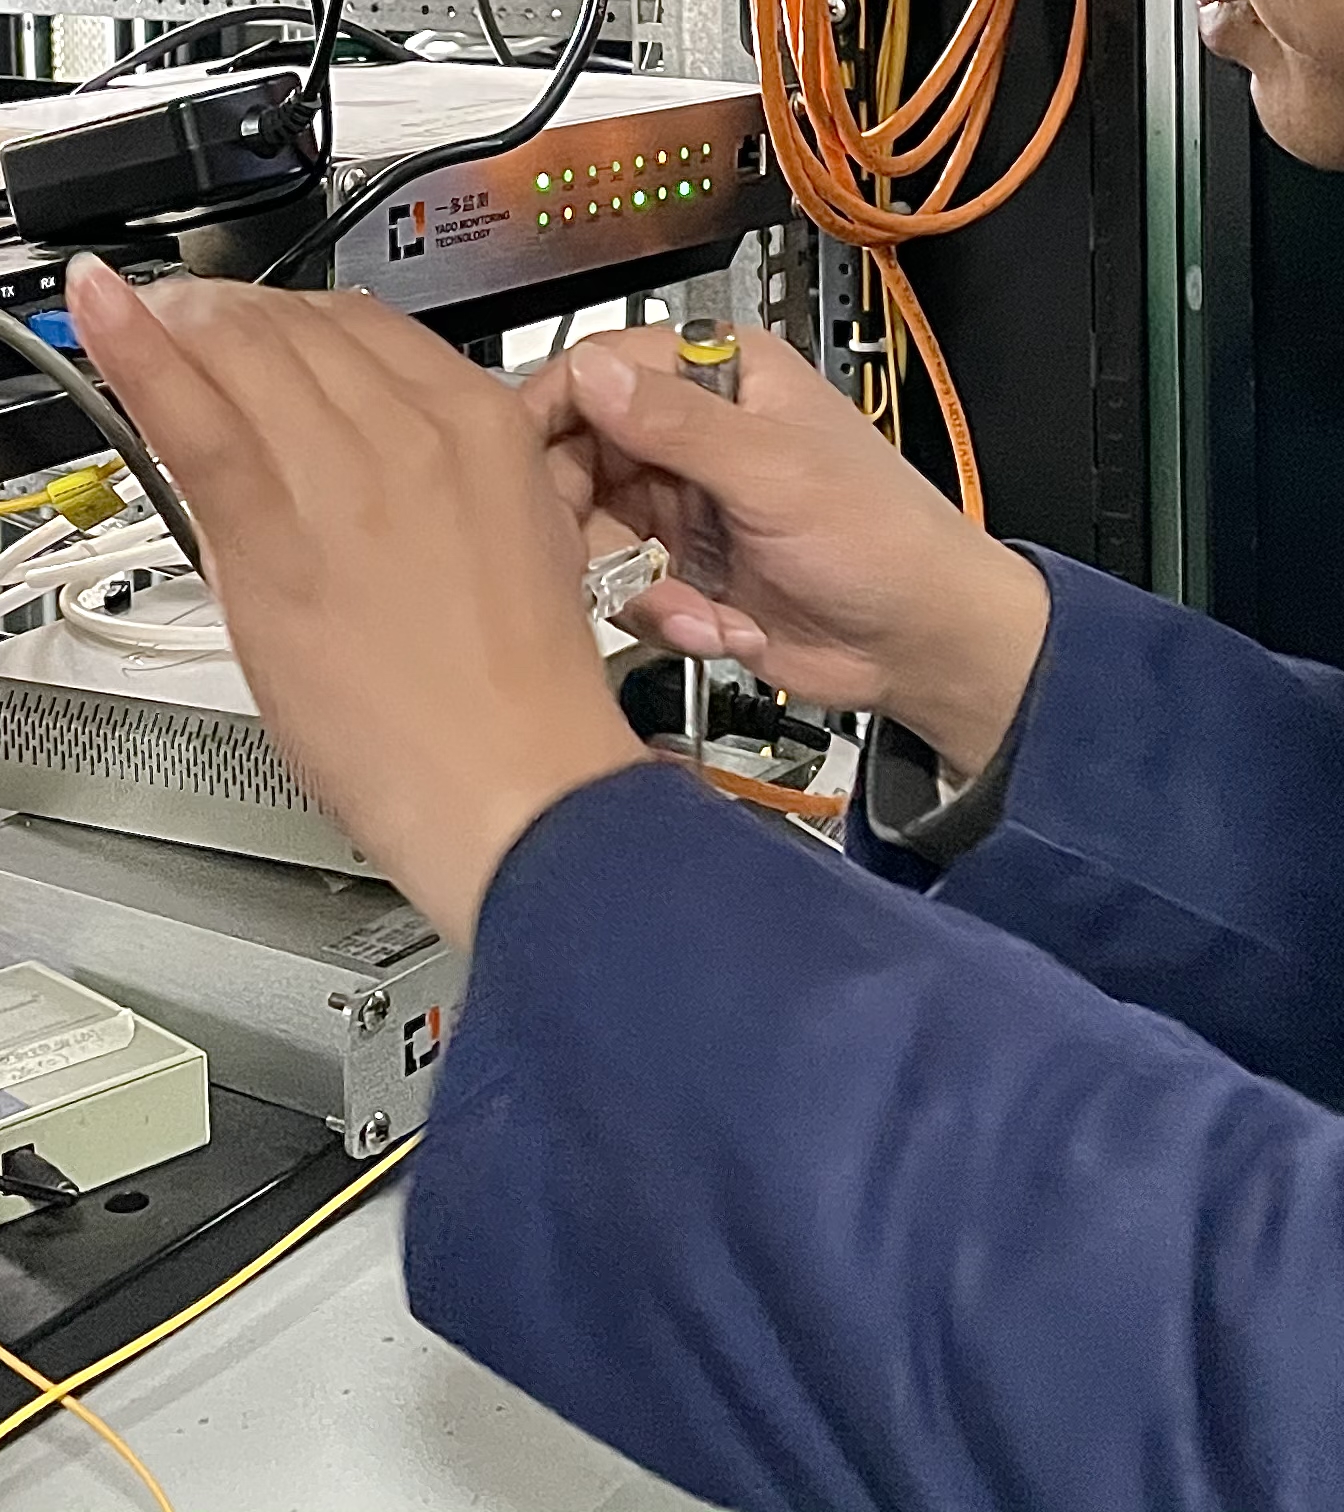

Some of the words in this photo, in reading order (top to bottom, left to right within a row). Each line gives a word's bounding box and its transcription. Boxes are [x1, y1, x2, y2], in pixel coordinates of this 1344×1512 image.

[435, 221, 458, 235] YADO
[459, 210, 511, 230] MONITORING
[435, 228, 491, 248] TECHNOLOGY
[0, 285, 15, 299] TX
[40, 276, 56, 290] RX
